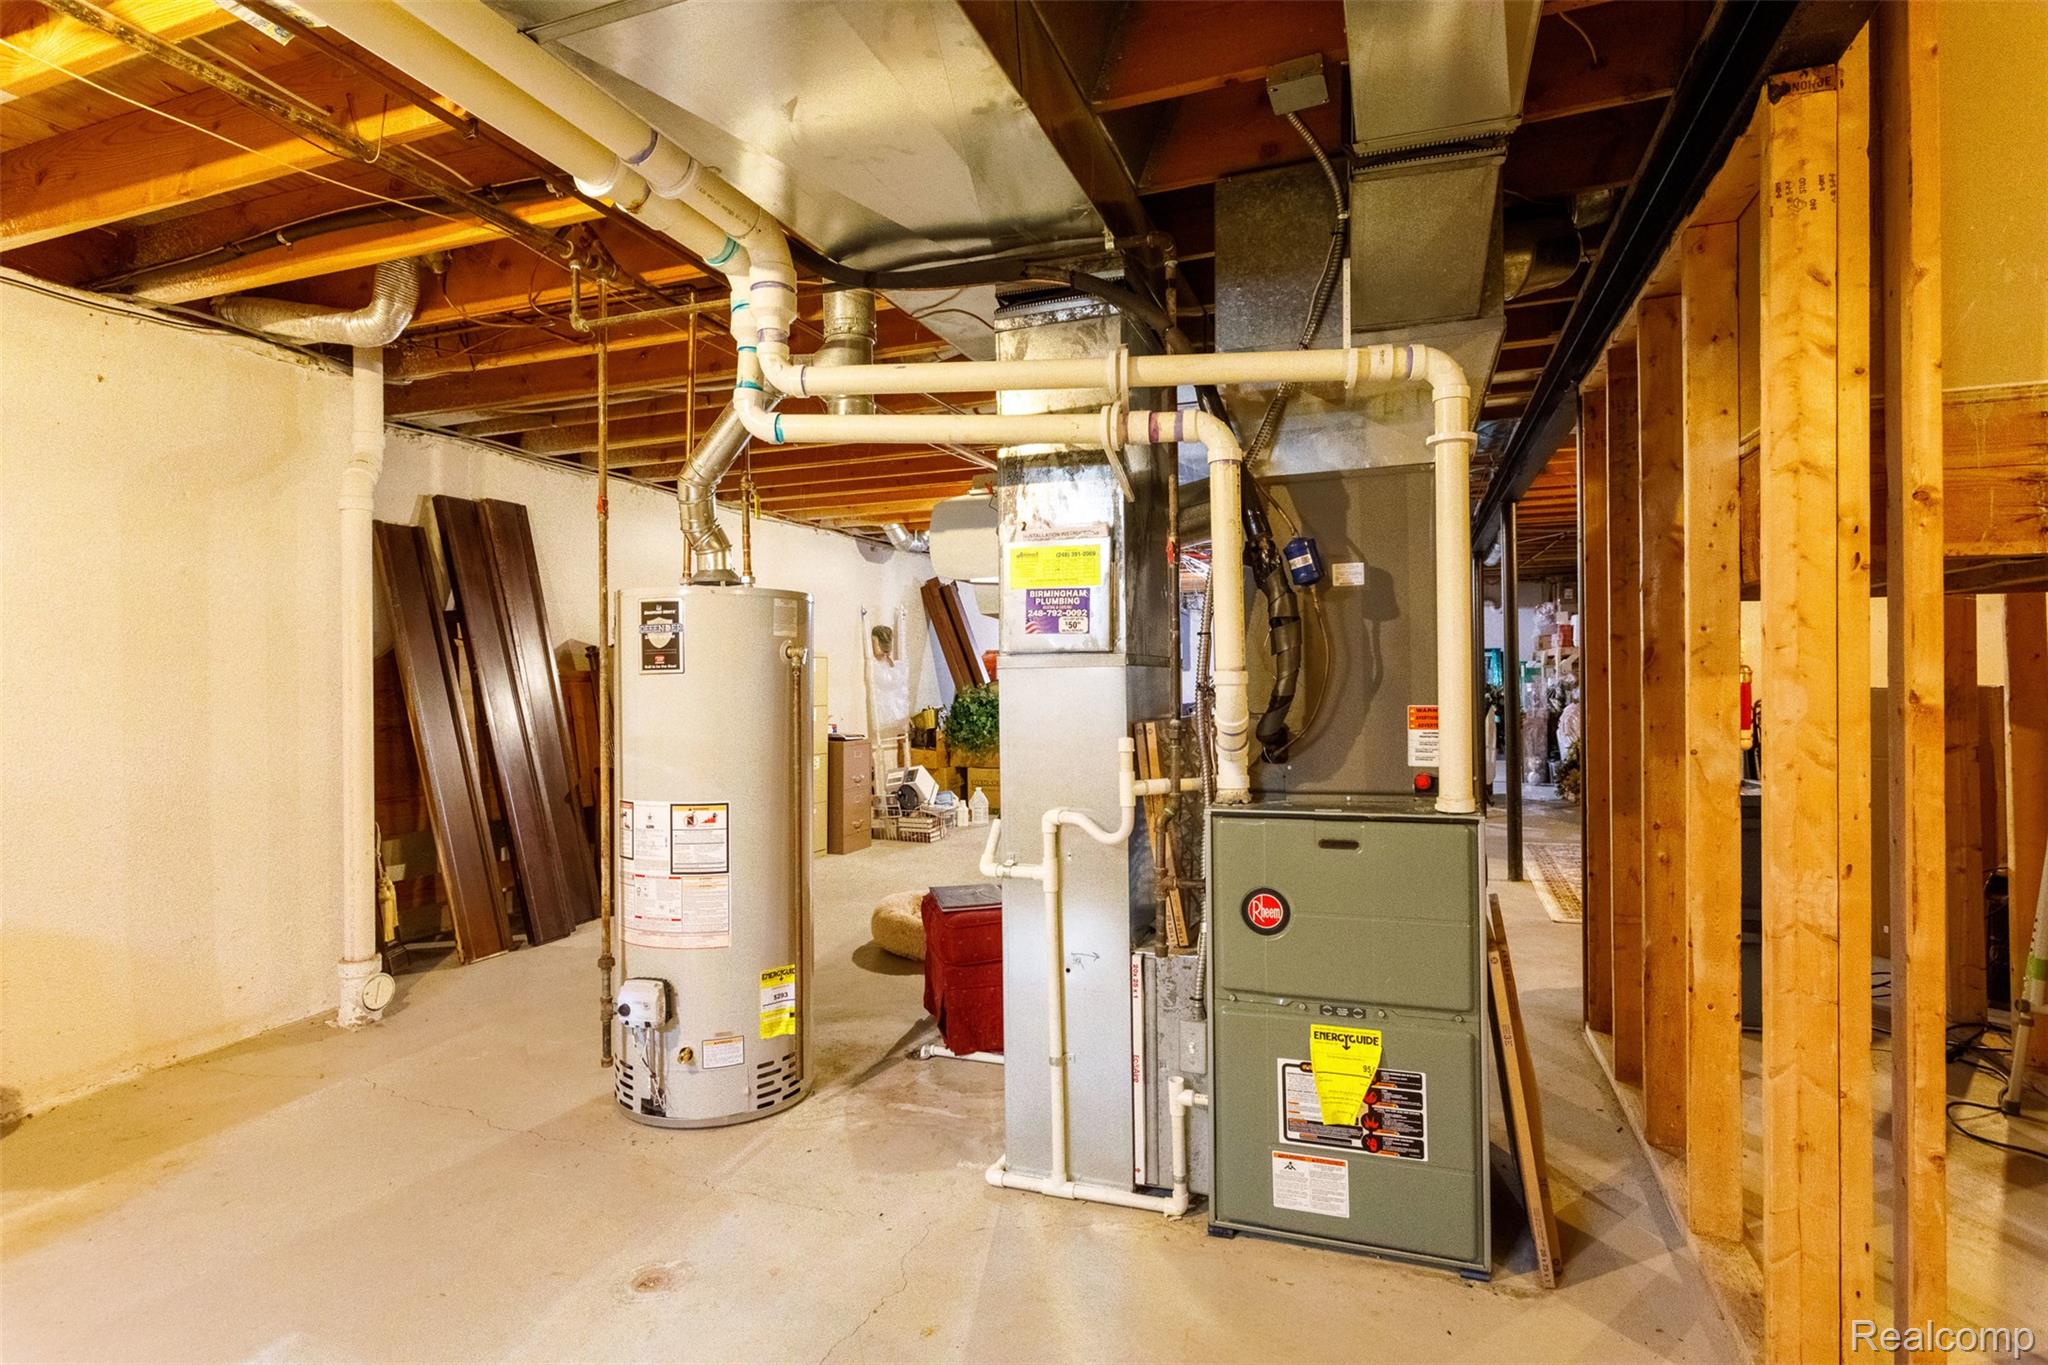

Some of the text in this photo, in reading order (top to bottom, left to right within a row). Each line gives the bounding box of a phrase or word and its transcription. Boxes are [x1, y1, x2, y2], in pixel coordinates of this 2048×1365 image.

[1029, 589, 1088, 598] BIRMINGHAM
[1035, 597, 1080, 605] PLUMBING
[639, 623, 684, 634] DEFENDER
[1252, 894, 1281, 923] Rheem
[1313, 1030, 1380, 1047] ENERGYGUIDE
